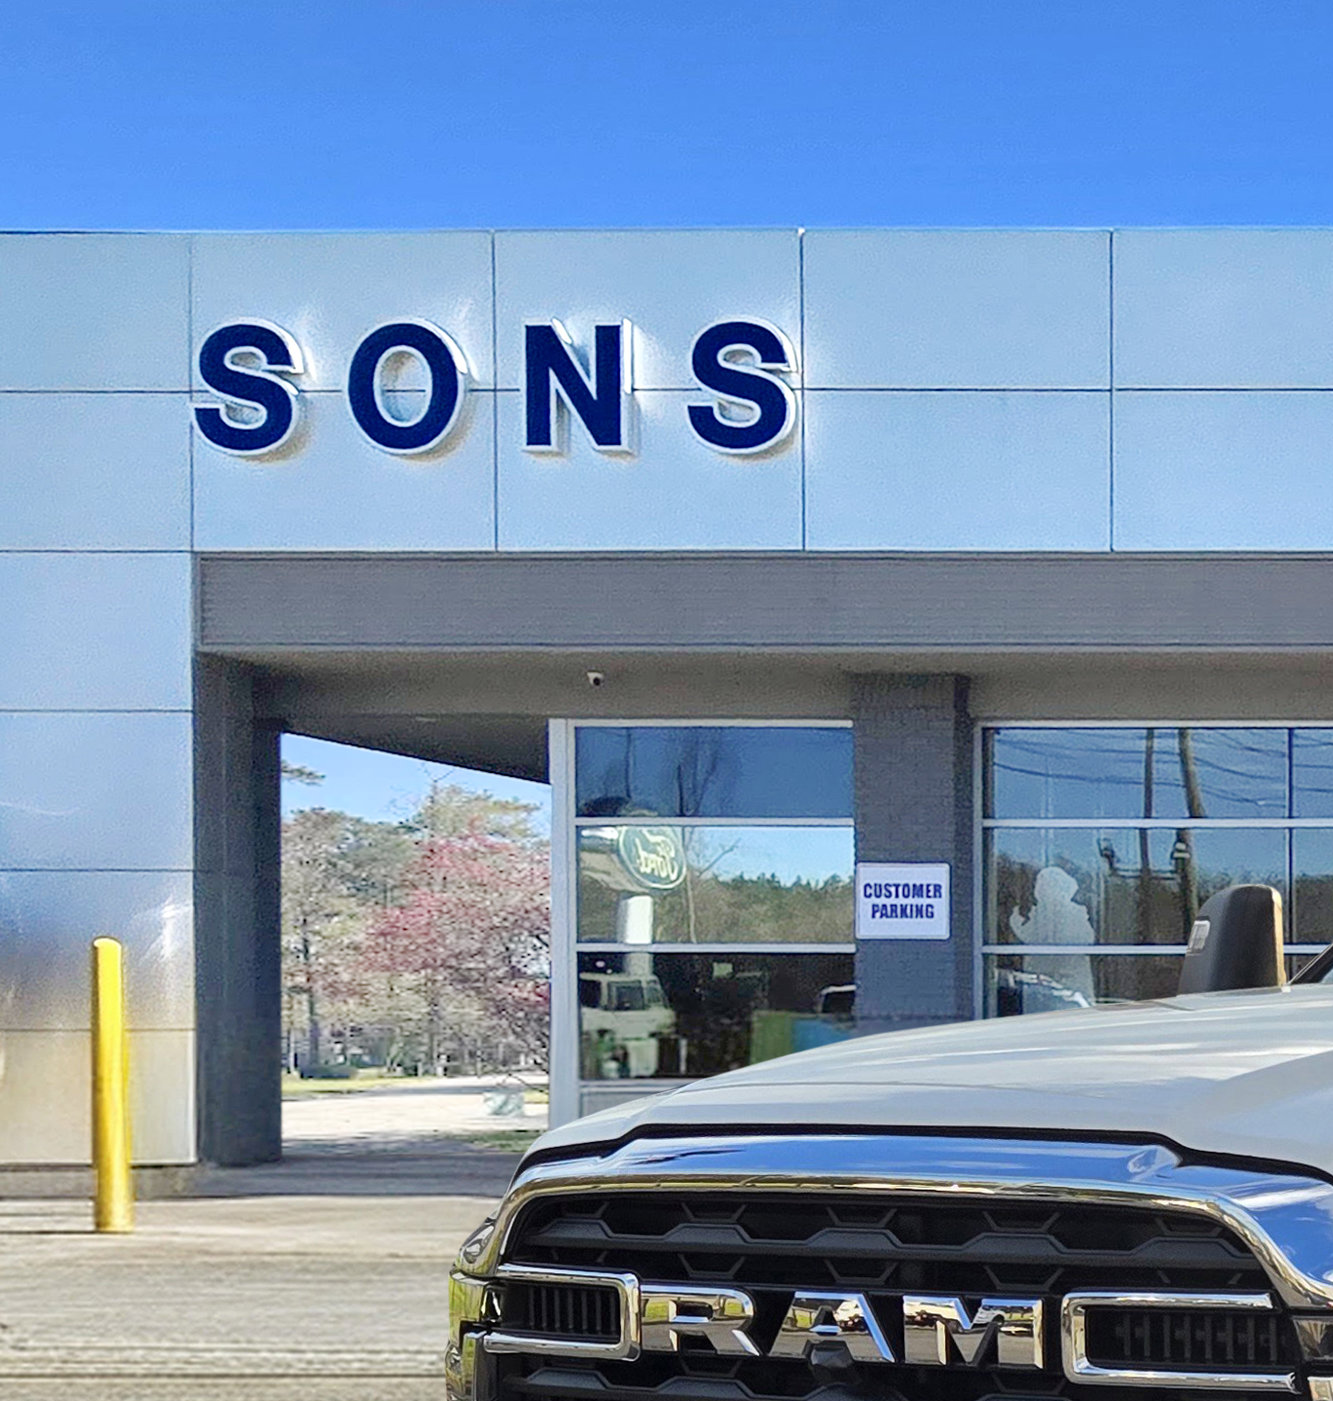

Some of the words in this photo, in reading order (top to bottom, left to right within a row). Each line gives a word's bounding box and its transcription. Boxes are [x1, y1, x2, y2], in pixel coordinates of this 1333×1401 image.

[193, 318, 797, 455] SONS
[862, 882, 943, 900] CUSTOMER
[871, 902, 935, 920] PARKING
[639, 1283, 1045, 1370] RAM
